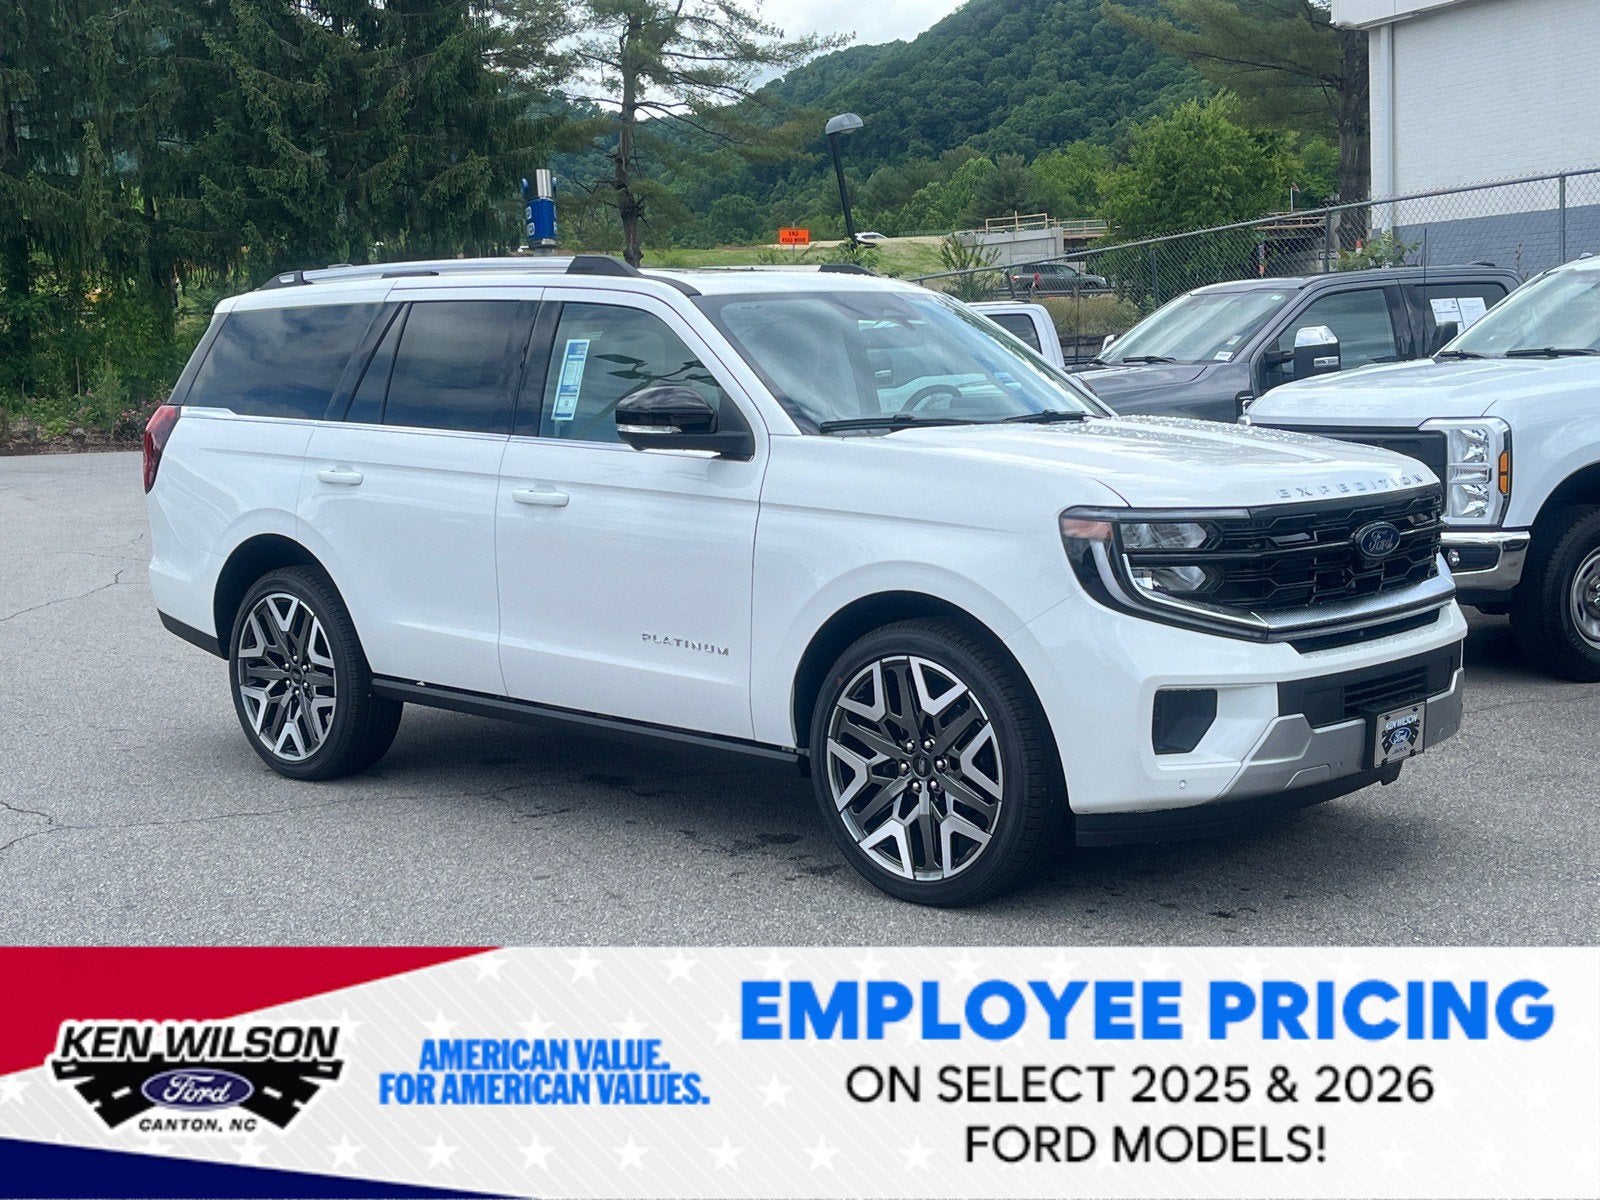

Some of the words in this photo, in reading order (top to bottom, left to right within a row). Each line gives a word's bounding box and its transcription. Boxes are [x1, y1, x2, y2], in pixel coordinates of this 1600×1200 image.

[1275, 473, 1424, 499] EXPEDITION
[1368, 530, 1395, 551] Ford
[641, 633, 730, 656] PLATINUM
